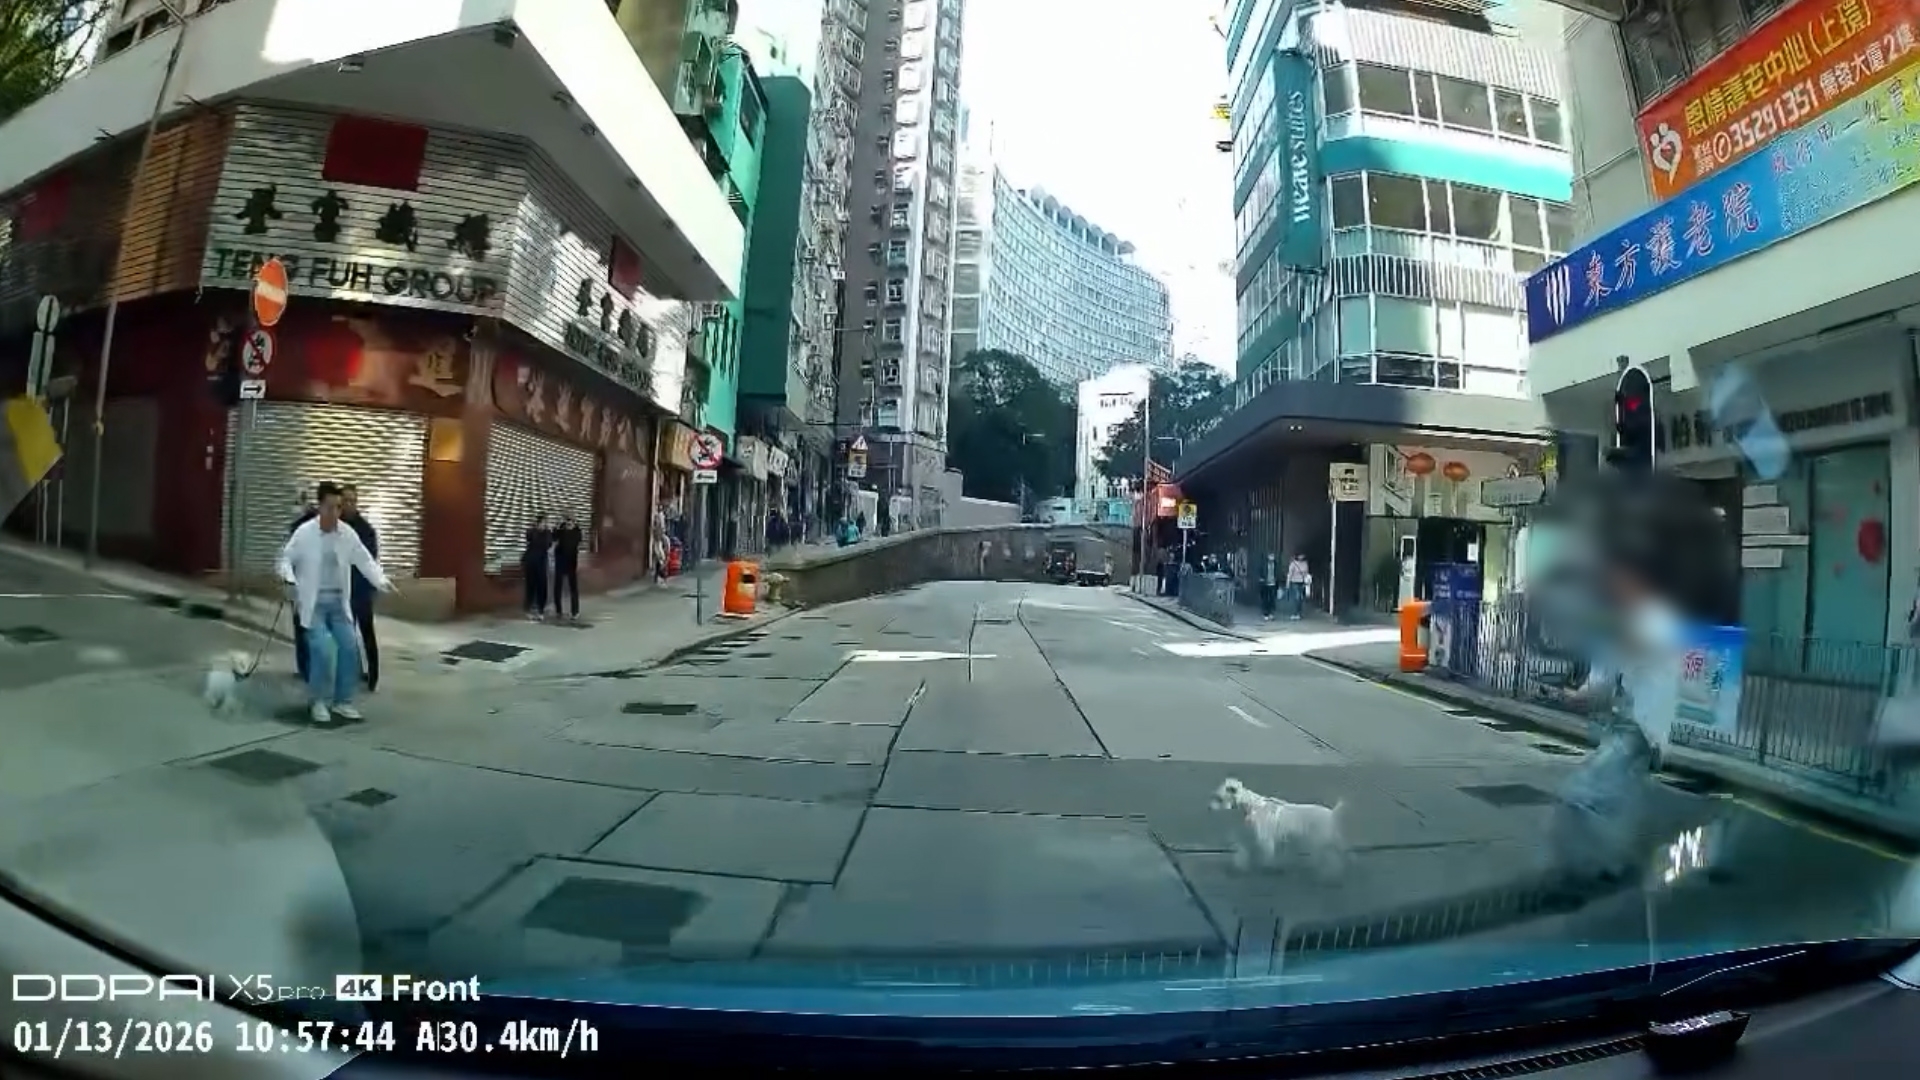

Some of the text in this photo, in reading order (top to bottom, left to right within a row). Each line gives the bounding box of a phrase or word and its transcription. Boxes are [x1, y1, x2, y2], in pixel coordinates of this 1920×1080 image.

[1728, 78, 1820, 152] 35291351
[309, 256, 370, 291] FUH
[383, 264, 498, 304] GROUP
[1584, 181, 1761, 306] 東方護老院
